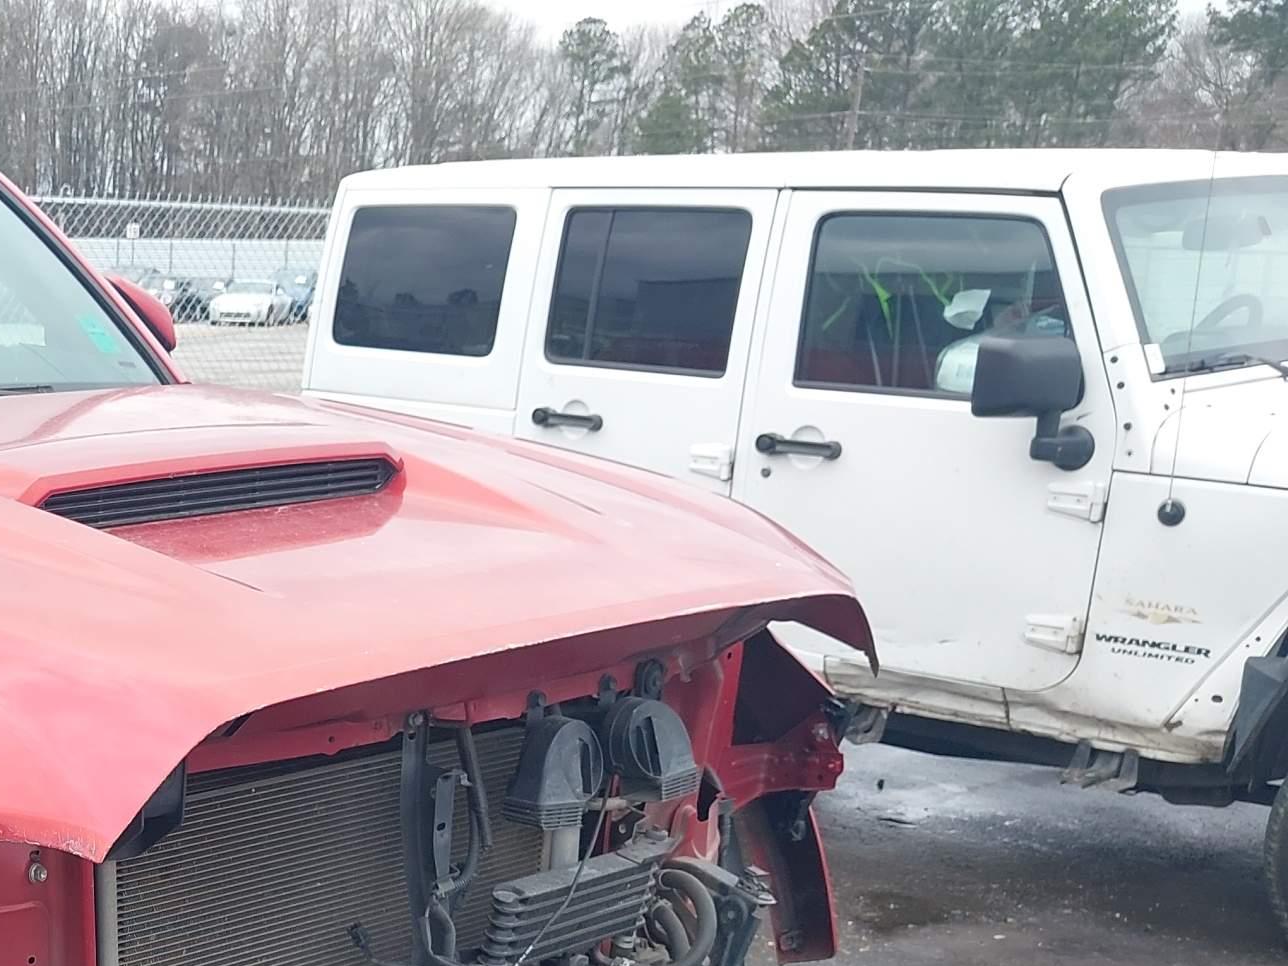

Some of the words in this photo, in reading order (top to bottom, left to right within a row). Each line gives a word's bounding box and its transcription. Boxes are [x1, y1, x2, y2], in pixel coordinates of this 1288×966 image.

[1124, 596, 1199, 616] SAHARA
[1094, 632, 1212, 659] WRANGLER
[1110, 646, 1196, 666] UNLIMITED
